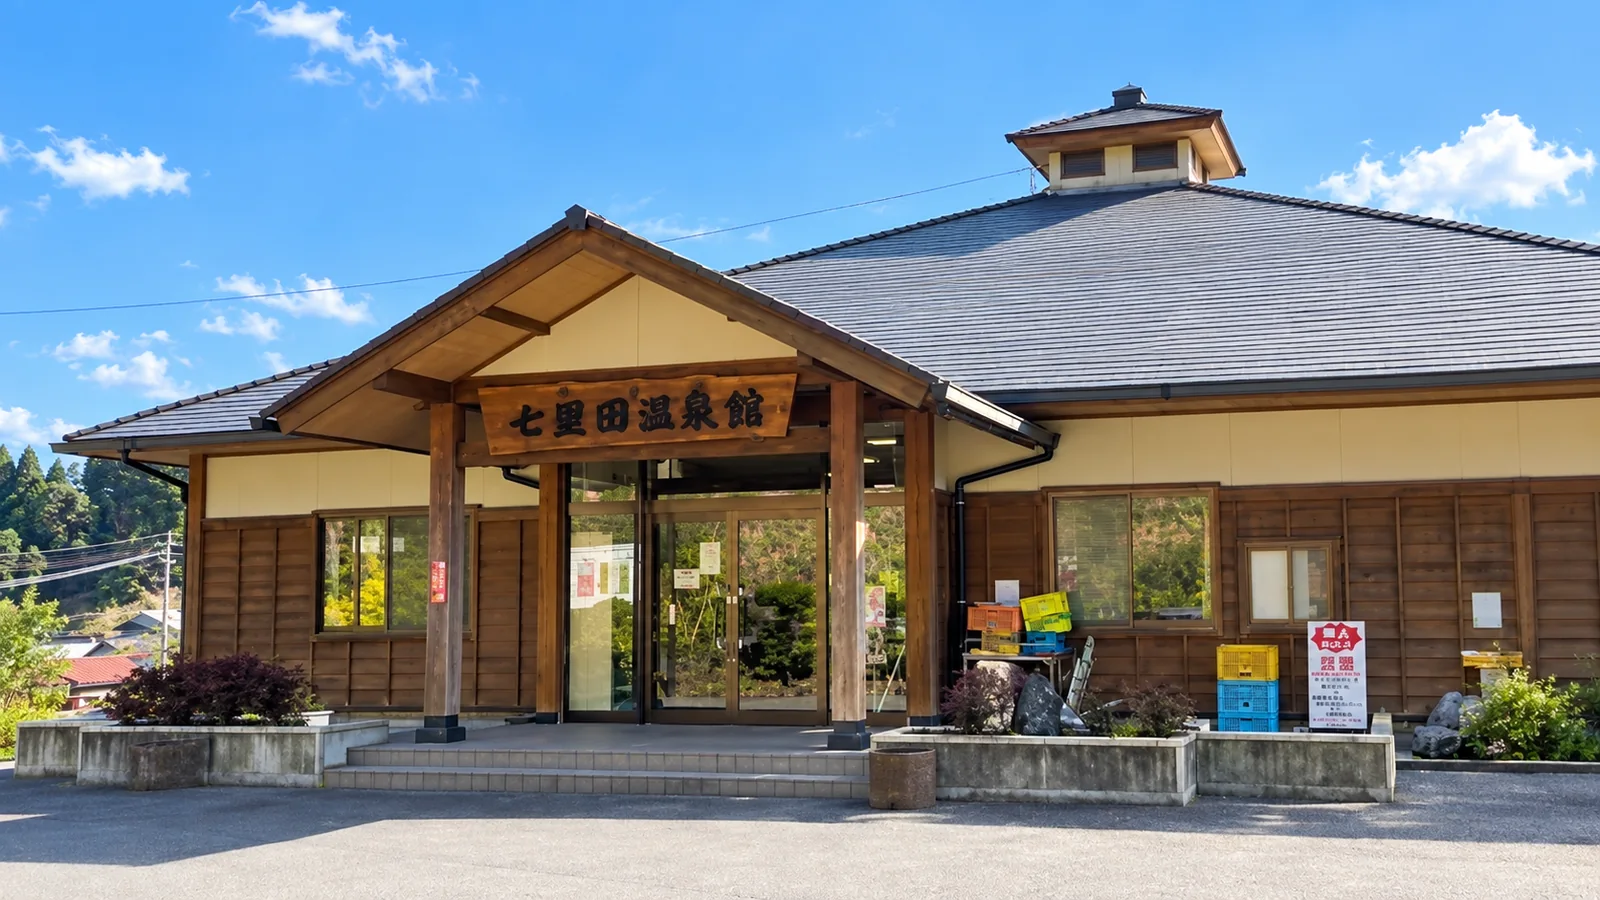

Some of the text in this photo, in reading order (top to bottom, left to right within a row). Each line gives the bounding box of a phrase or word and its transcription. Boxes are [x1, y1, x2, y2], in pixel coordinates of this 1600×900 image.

[509, 388, 765, 438] 七里田温泉館
